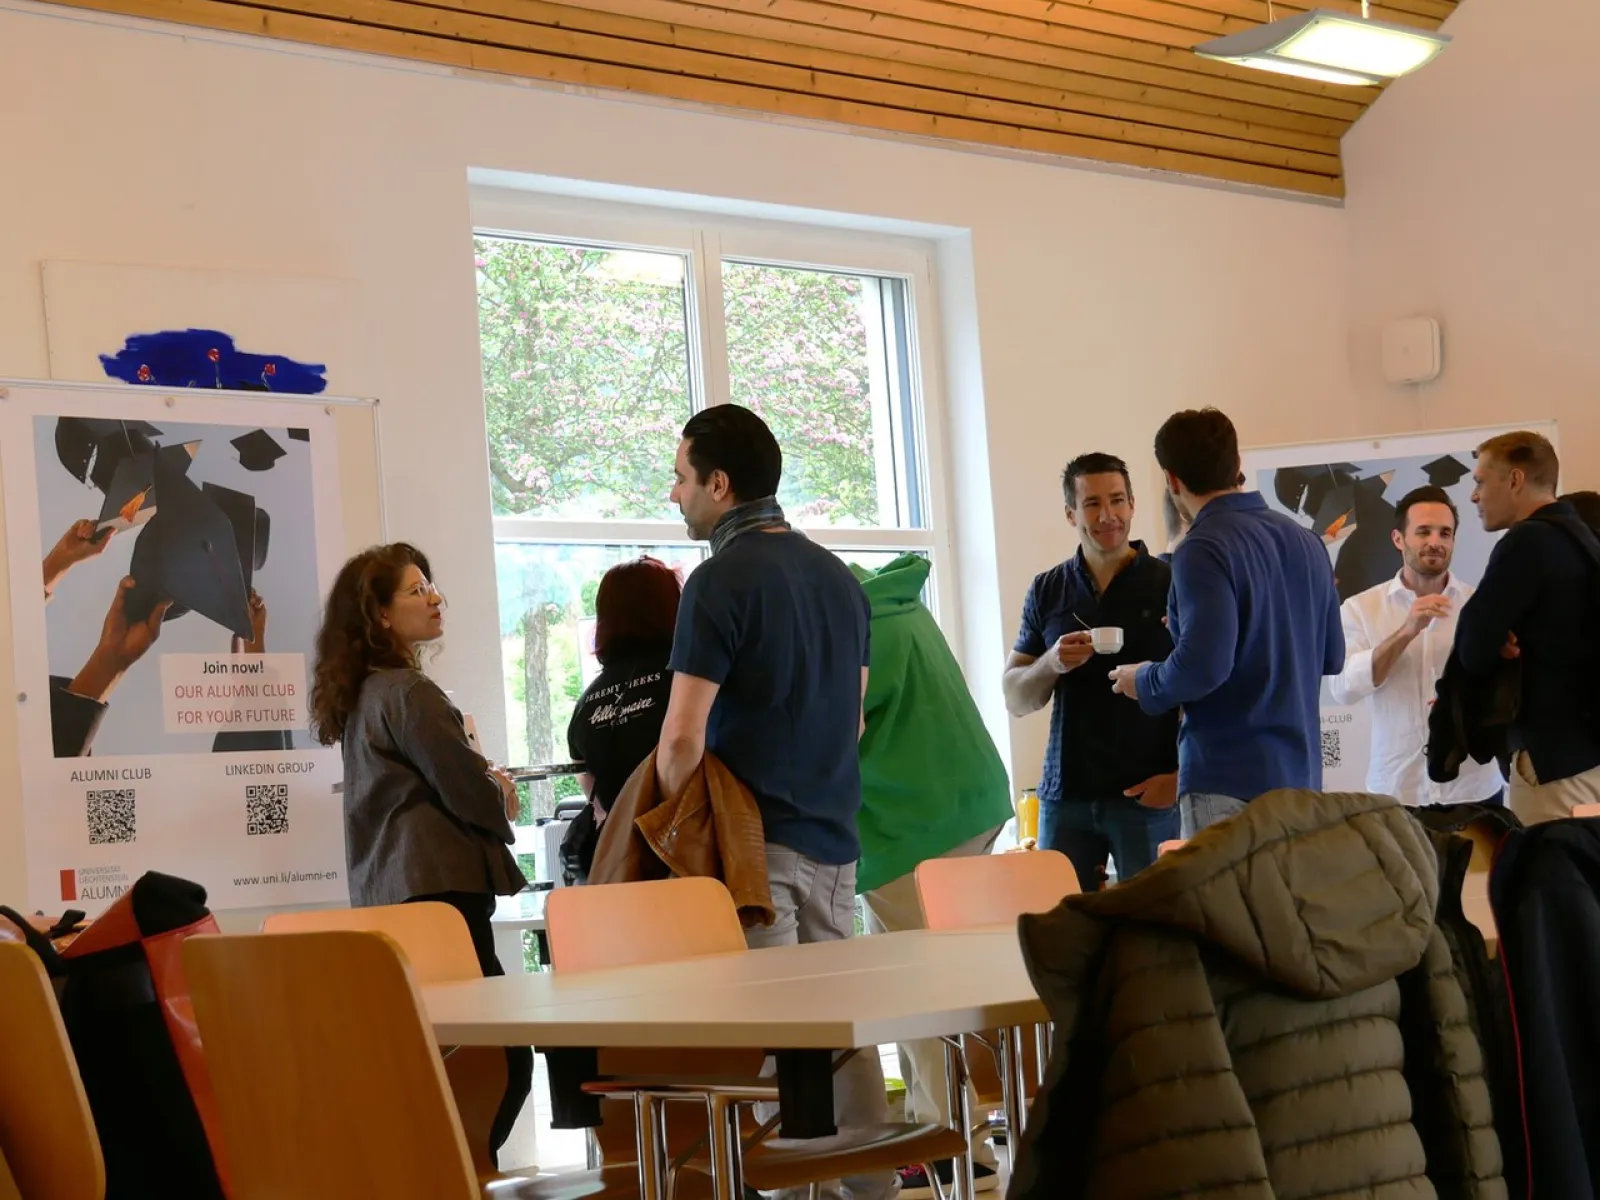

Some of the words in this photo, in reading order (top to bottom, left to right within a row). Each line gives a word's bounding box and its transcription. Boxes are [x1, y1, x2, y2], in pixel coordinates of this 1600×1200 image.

[203, 661, 228, 675] Join
[231, 660, 264, 674] now!
[174, 685, 204, 699] OUR
[206, 684, 259, 698] ALUMNI
[262, 683, 296, 697] CLUB
[584, 683, 621, 704] JEREMY
[177, 710, 203, 724] FOR
[206, 709, 242, 724] YOUR
[246, 708, 296, 722] FUTURE
[70, 768, 119, 783] ALUMNI
[121, 767, 152, 780] CLUB
[225, 763, 275, 776] LINKEDIN
[277, 761, 316, 774] GROUP
[79, 873, 129, 884] LIECHTENSTEIN
[233, 870, 338, 886] www.uni.li/alumni-en
